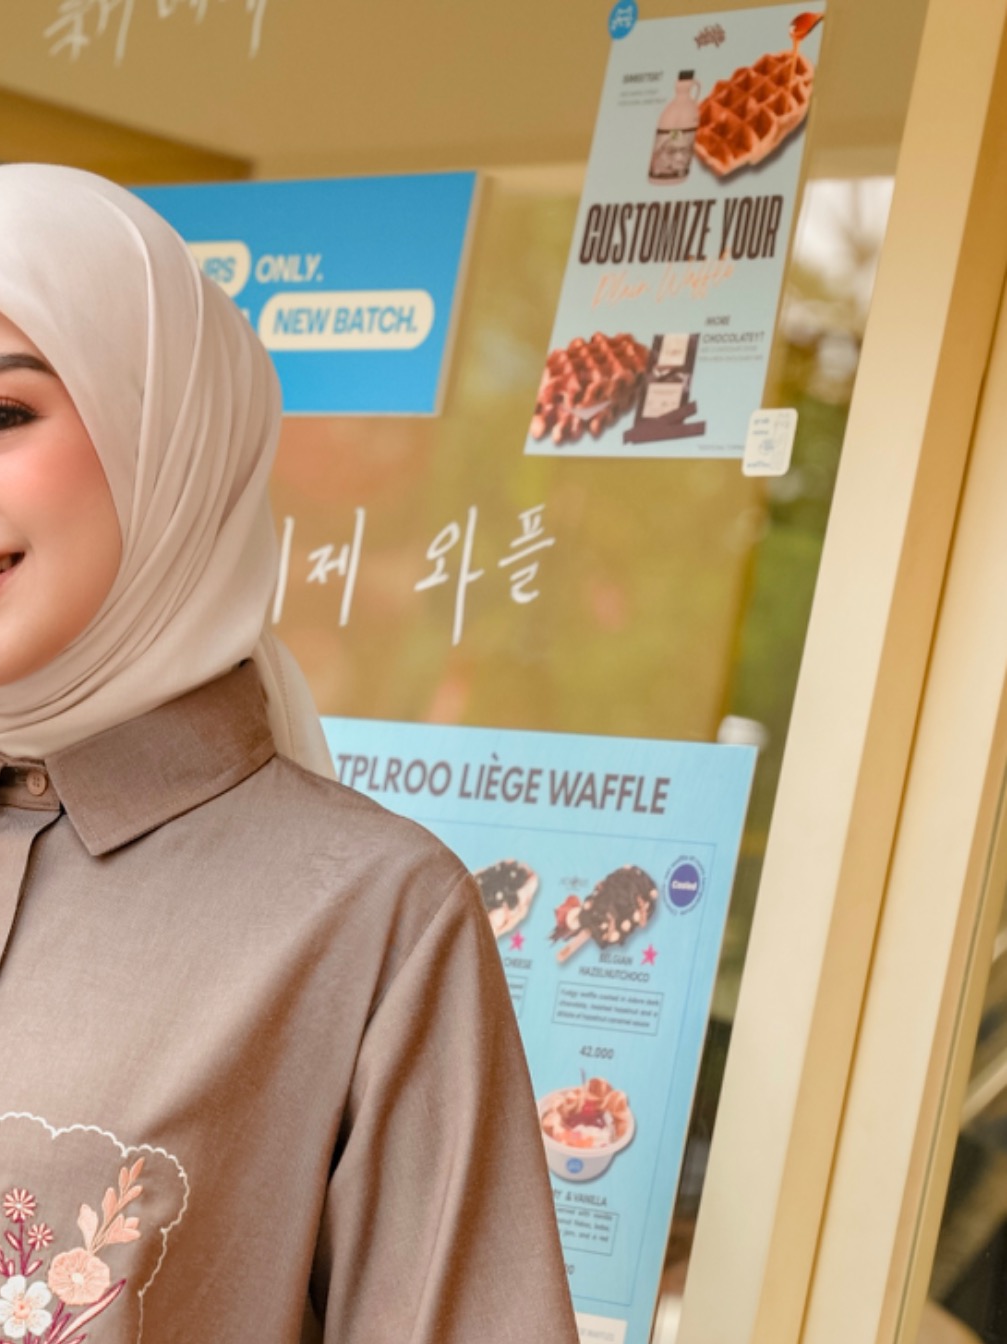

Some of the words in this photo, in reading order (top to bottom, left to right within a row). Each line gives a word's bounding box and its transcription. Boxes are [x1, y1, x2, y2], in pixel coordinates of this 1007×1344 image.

[578, 200, 717, 264] CUSTOMIZE
[719, 195, 783, 260] YOUR
[255, 254, 324, 283] ONLY.
[273, 306, 330, 335] NEW
[332, 304, 419, 334] BATCH.
[414, 503, 556, 646] 와플
[458, 751, 543, 806] LIÈGE
[548, 770, 671, 815] WAFFLE
